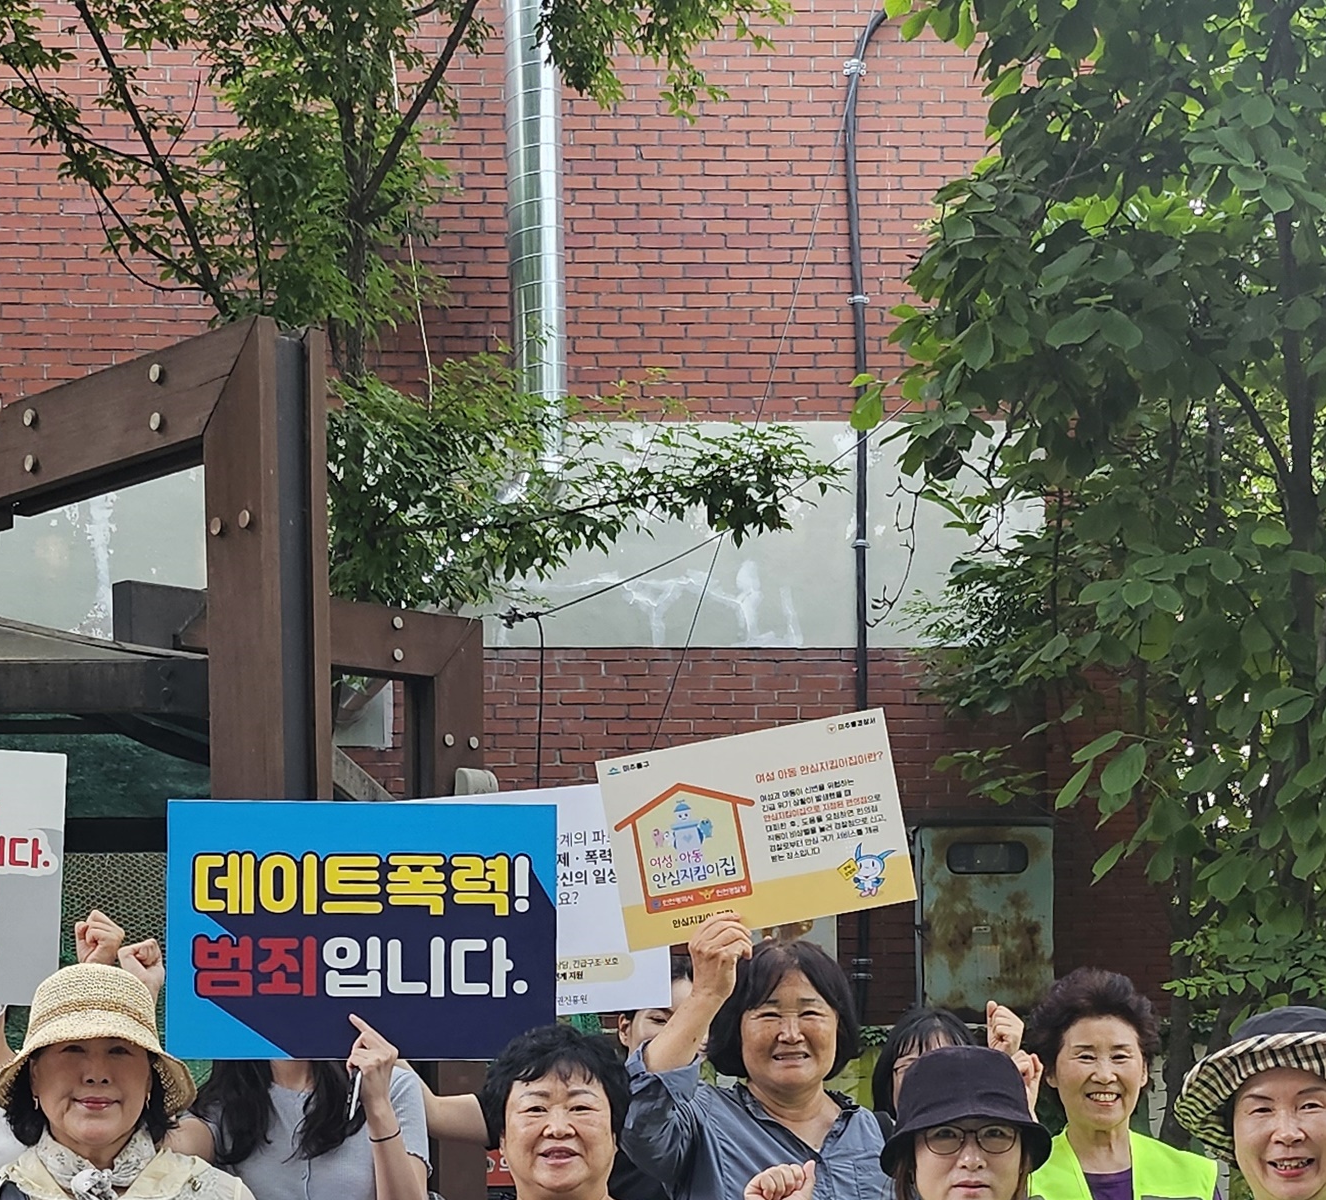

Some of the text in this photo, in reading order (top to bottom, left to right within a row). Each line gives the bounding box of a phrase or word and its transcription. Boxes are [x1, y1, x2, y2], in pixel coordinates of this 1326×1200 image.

[557, 831, 586, 847] 계의
[585, 848, 612, 865] 폭력
[650, 849, 703, 868] 여성 아동
[556, 869, 587, 887] 신의
[653, 856, 736, 889] 안심지킴이집
[192, 853, 532, 916] 데이트폭력!
[193, 936, 530, 999] 범죄입니다.
